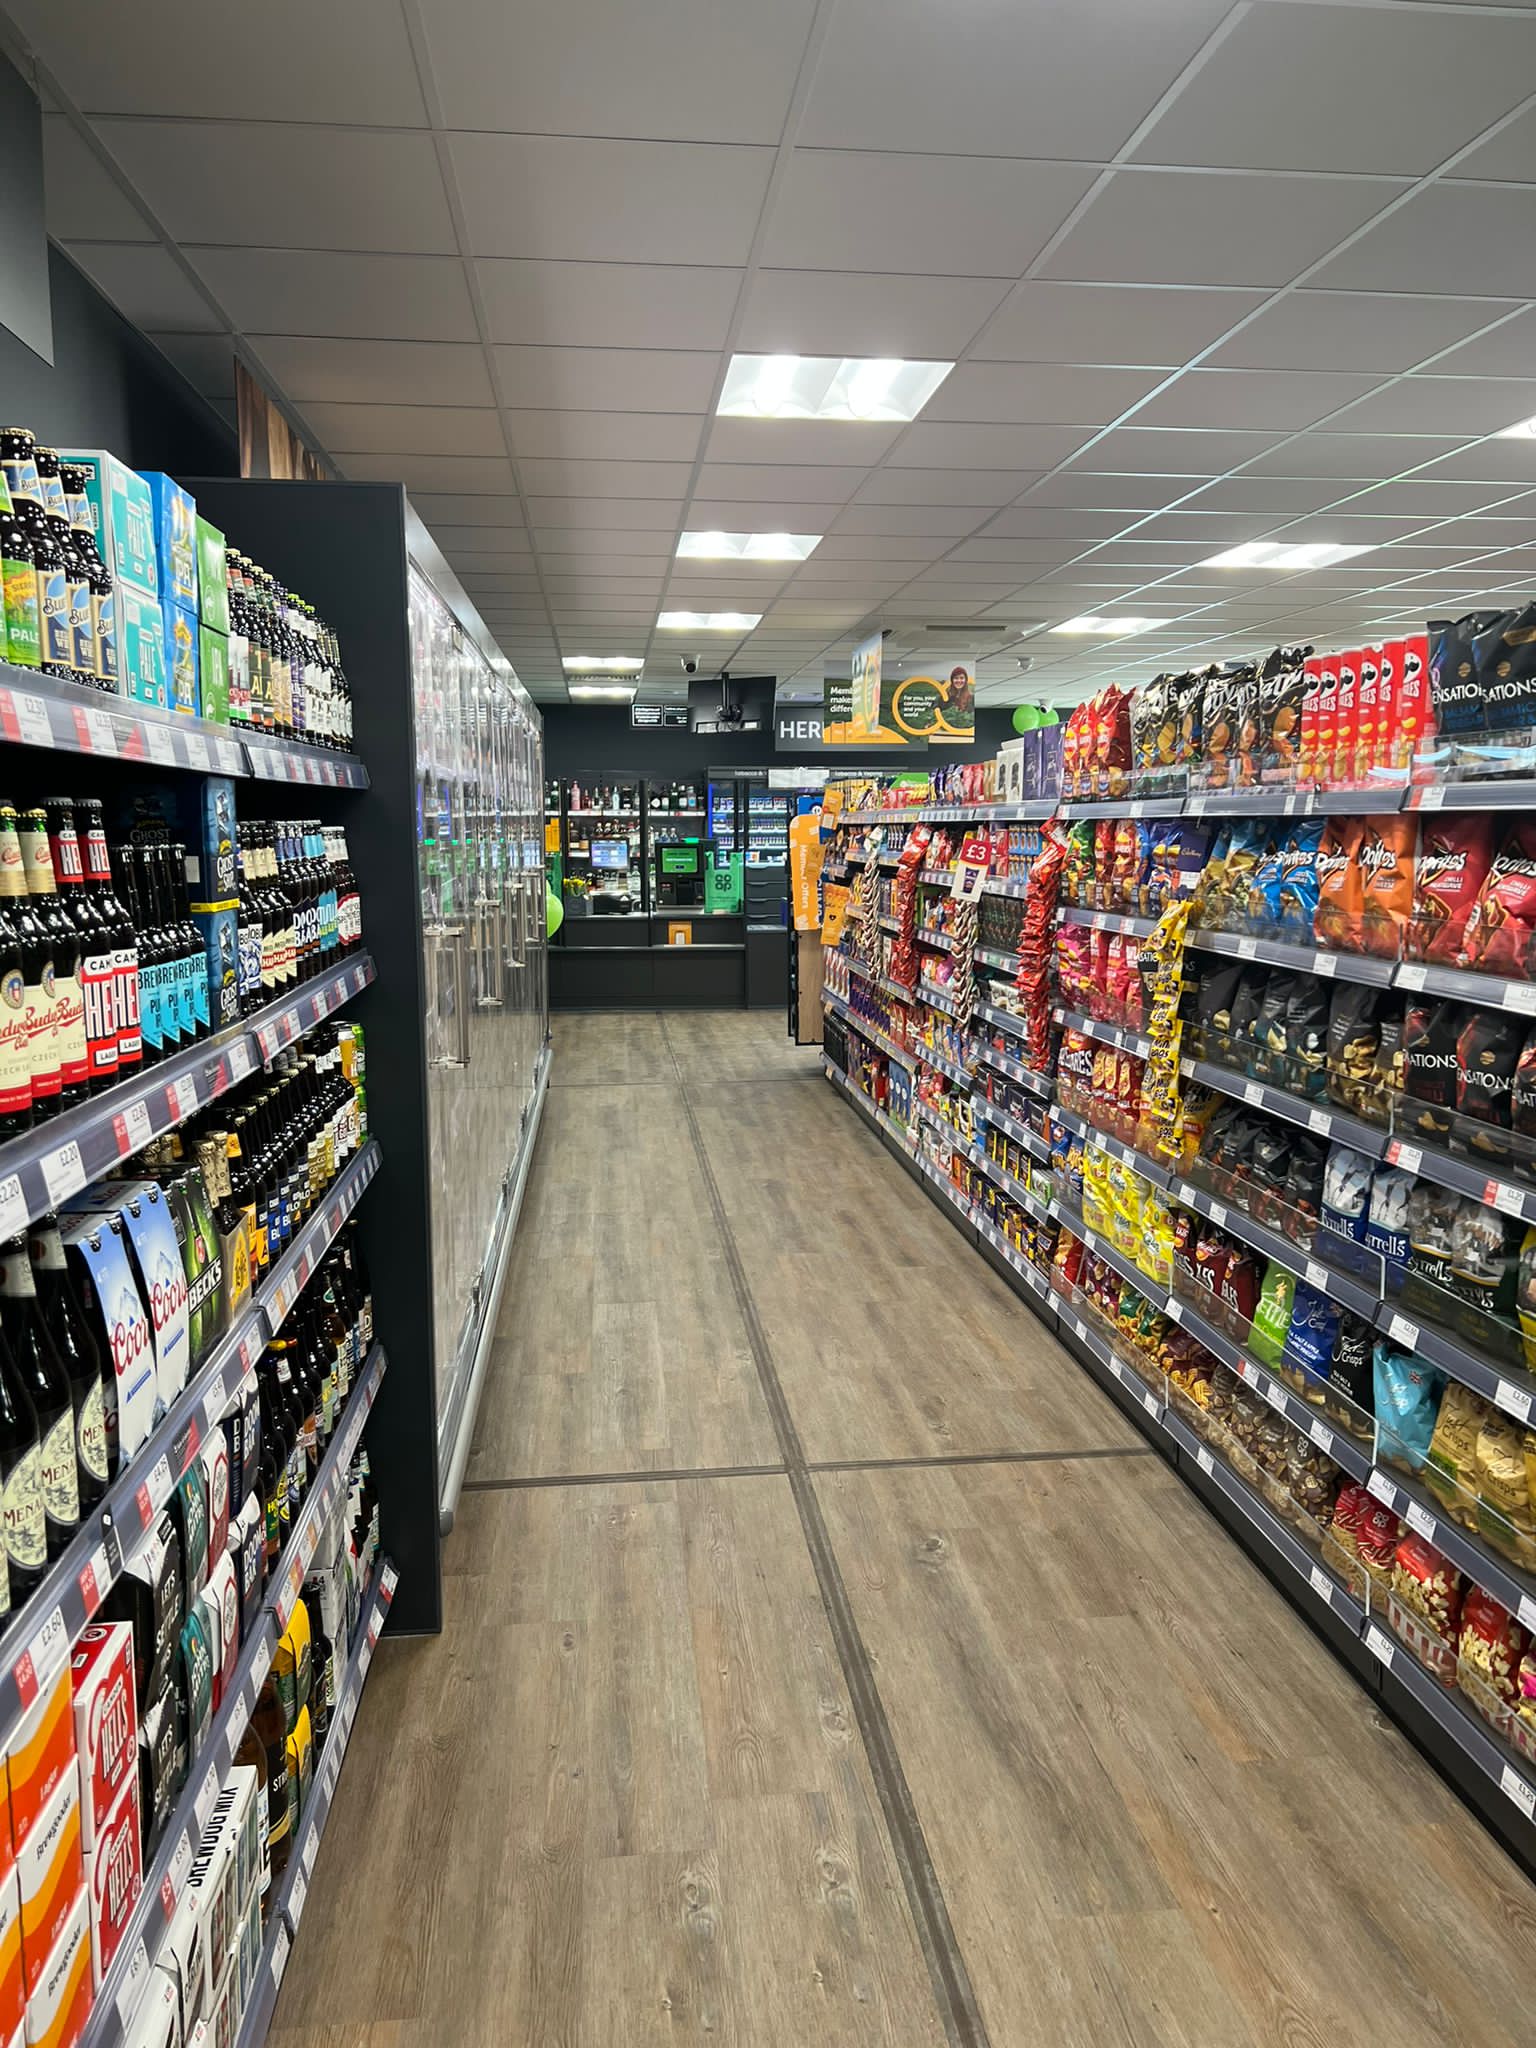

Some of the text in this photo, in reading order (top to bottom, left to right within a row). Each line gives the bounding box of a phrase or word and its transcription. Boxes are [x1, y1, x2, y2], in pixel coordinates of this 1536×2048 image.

[780, 721, 824, 739] HER
[965, 844, 987, 861] £3
[110, 1317, 148, 1376] Coor
[101, 1687, 129, 1779] HELLS
[108, 1828, 133, 1923] HELLS
